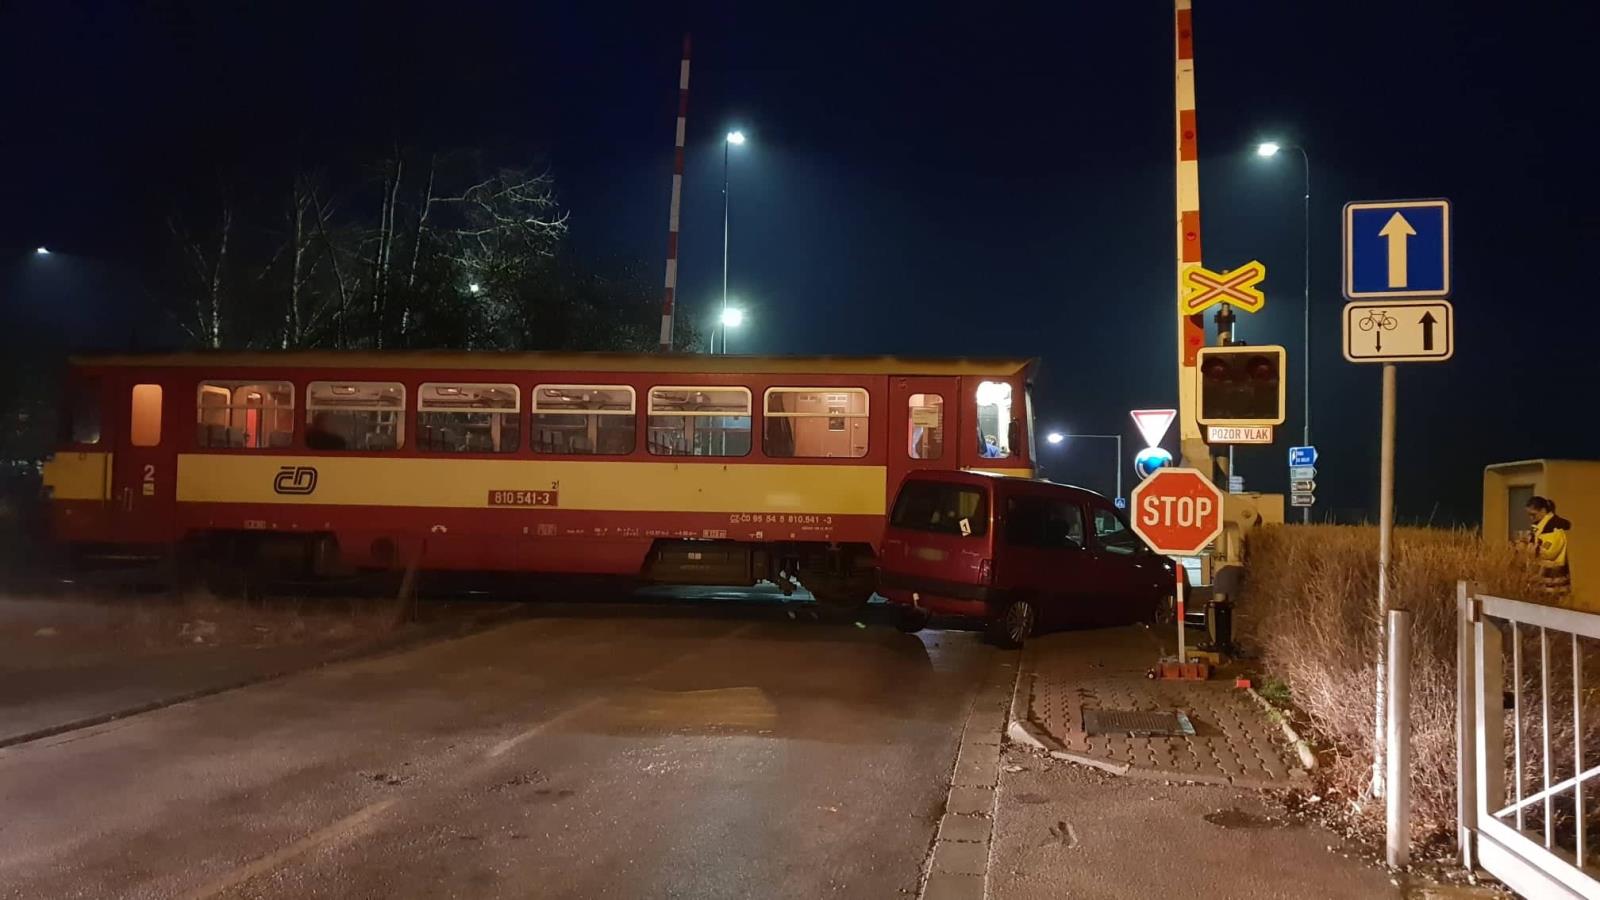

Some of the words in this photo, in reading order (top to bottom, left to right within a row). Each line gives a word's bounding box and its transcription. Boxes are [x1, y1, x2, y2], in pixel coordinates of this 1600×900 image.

[1211, 429, 1241, 440] POZOR
[1245, 429, 1269, 440] VLAK
[143, 464, 155, 481] 2
[495, 491, 514, 504] 810
[516, 491, 550, 505] 541-3
[1143, 495, 1212, 528] STOP
